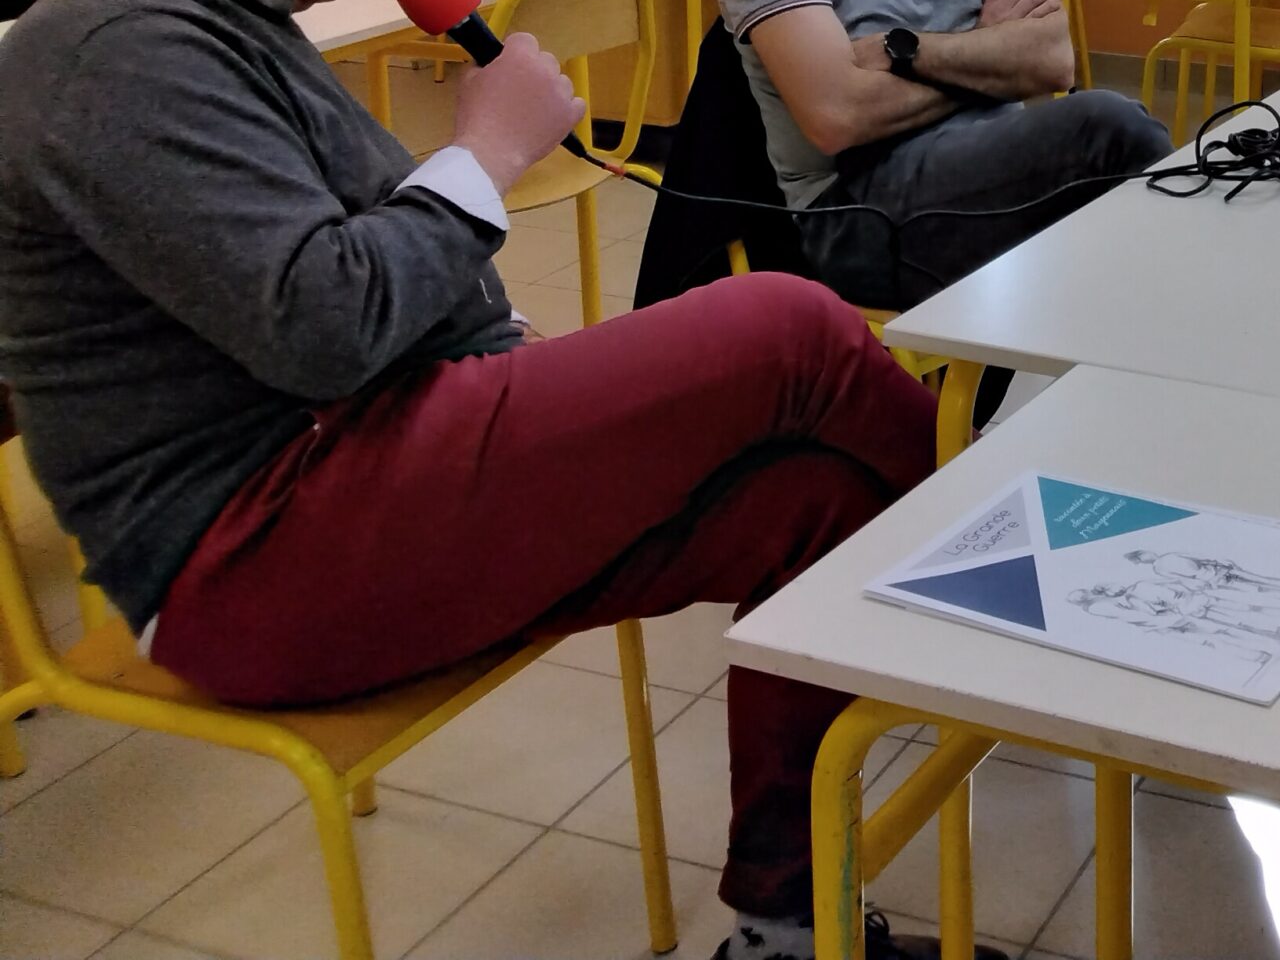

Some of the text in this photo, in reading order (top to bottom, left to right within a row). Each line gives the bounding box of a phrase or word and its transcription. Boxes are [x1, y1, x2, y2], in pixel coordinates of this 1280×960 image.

[943, 510, 1011, 556] La Grande
[973, 521, 1020, 552] Guerre
